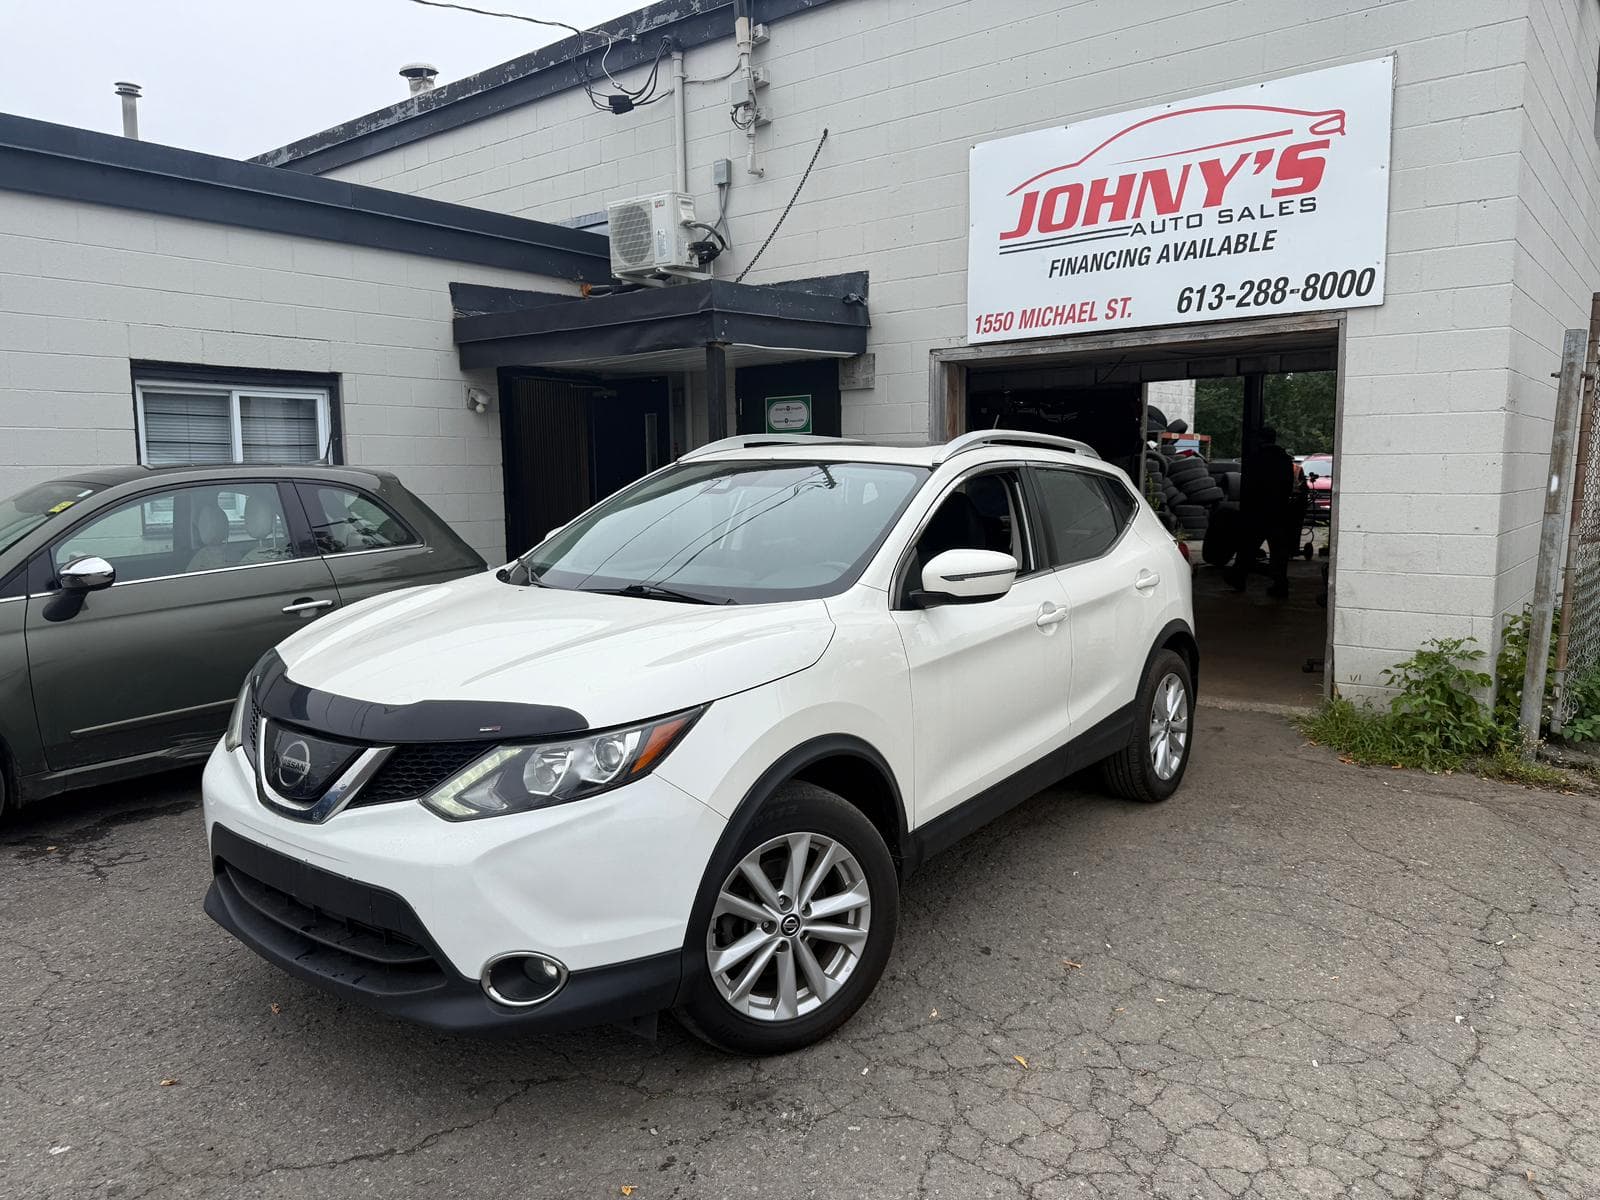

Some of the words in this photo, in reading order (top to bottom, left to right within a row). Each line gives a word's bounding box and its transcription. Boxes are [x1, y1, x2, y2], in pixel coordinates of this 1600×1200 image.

[1000, 139, 1330, 240] JOHNY'S
[1130, 212, 1203, 237] AUTO
[1217, 196, 1317, 225] SALES
[1048, 245, 1151, 279] FINANCING
[1156, 229, 1277, 264] AVAILABLE
[1176, 266, 1376, 314] 613-288-8000
[974, 311, 1015, 335] 1550
[1018, 300, 1098, 330] MICHAEL
[1104, 296, 1132, 320] ST.
